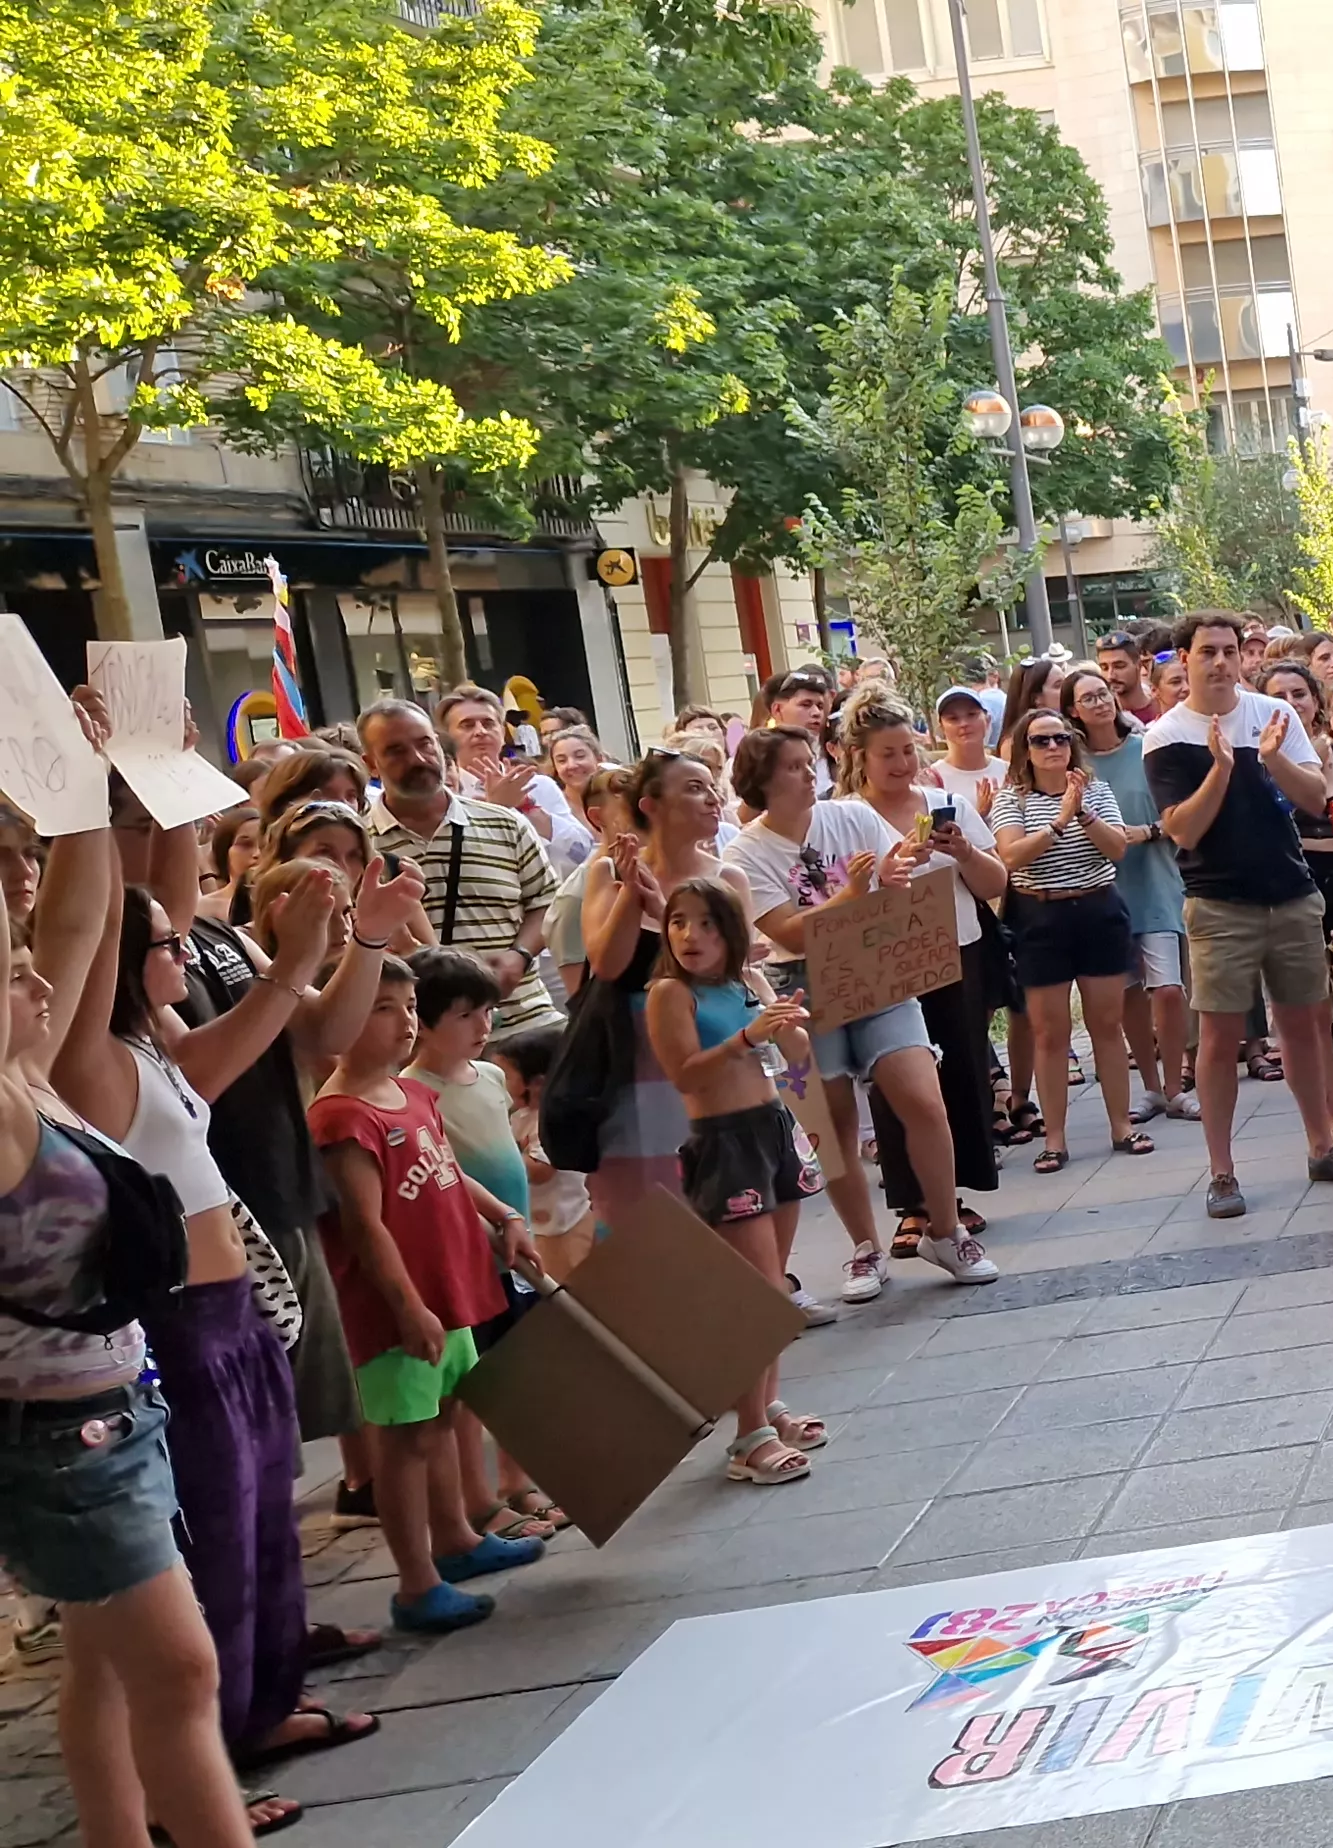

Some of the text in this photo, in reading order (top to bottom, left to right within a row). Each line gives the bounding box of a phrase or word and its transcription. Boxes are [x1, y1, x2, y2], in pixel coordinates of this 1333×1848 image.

[205, 549, 269, 575] CaixaBa
[910, 884, 935, 905] LA
[878, 926, 950, 965] PODER
[826, 978, 869, 1004] SER
[842, 992, 877, 1020] SIN
